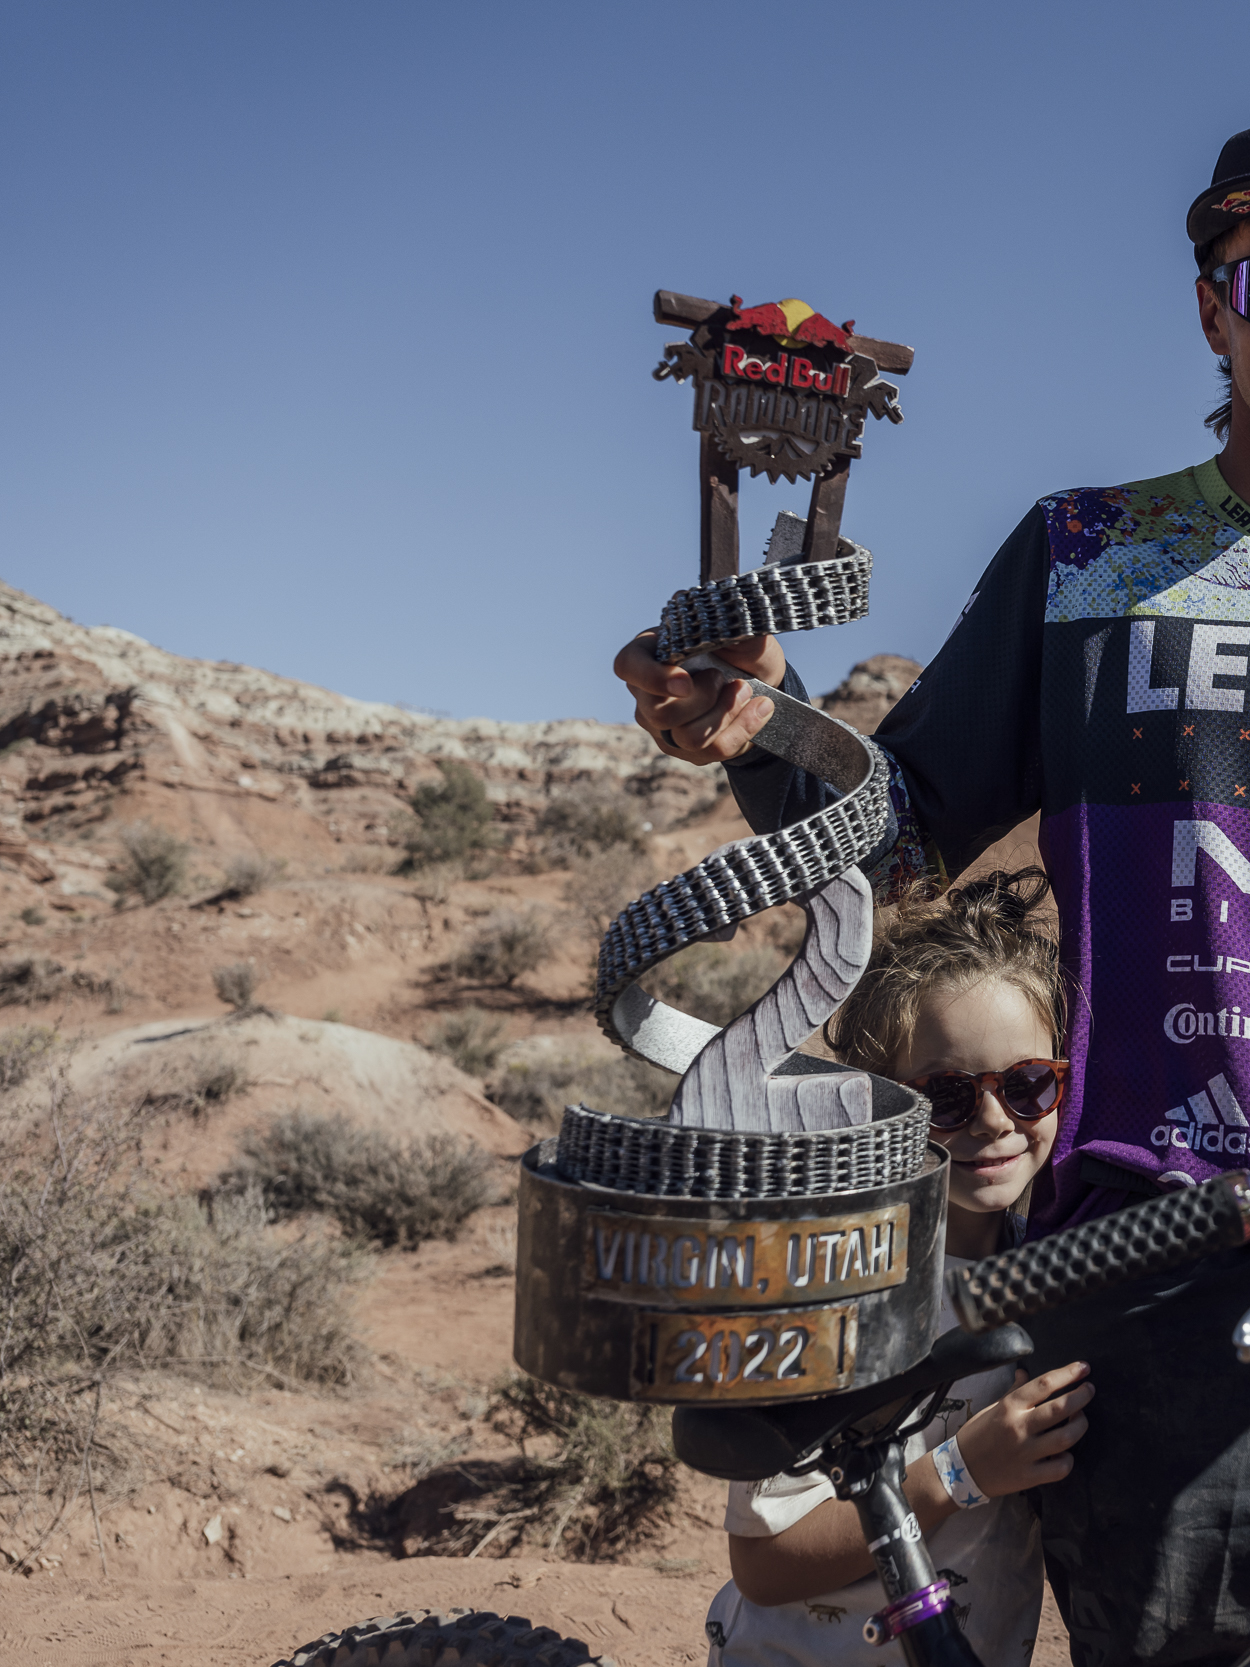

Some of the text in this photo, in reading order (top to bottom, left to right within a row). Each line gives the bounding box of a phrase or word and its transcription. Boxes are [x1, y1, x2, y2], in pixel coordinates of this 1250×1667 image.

[724, 344, 850, 398] Red Bull
[699, 379, 864, 458] RAMPAGE
[594, 1220, 897, 1295] VIRGIN, UTAH
[674, 1325, 810, 1384] 2022
